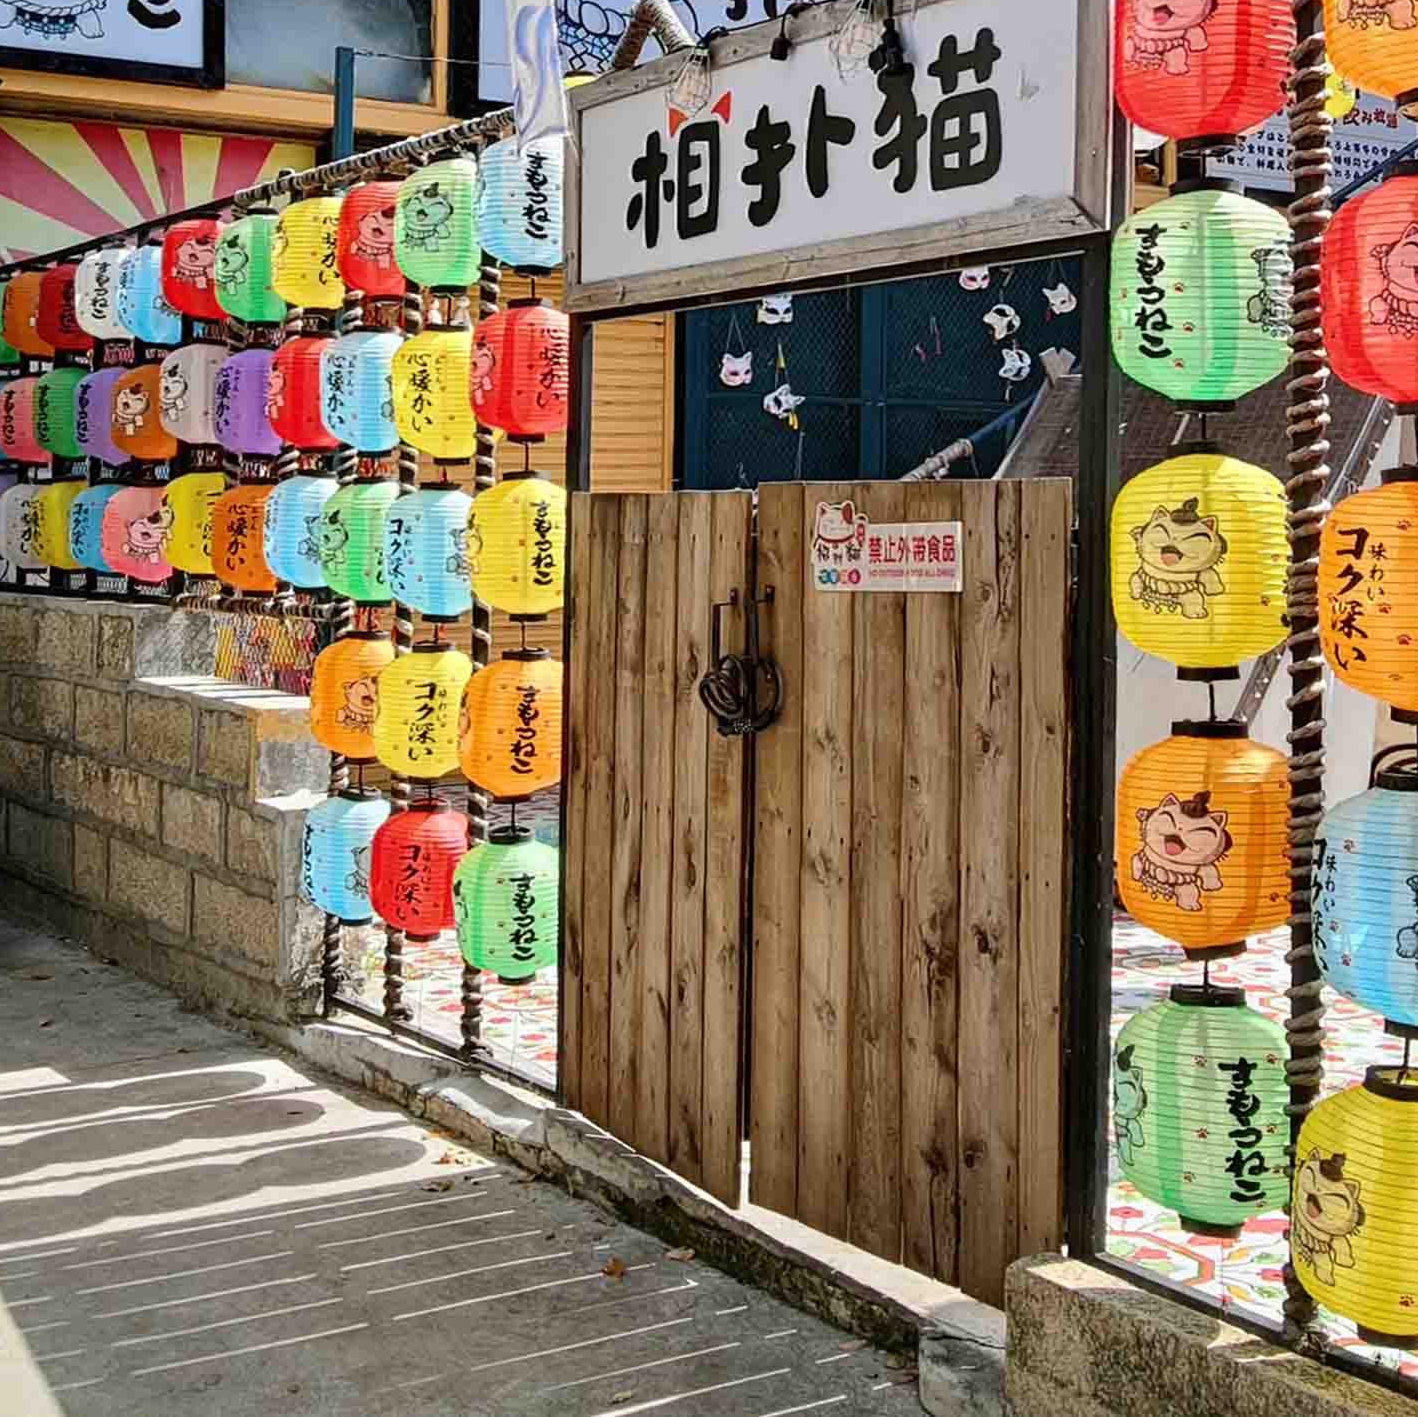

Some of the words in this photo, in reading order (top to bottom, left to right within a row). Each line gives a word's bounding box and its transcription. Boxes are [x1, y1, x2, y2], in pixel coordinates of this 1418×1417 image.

[626, 27, 1002, 249] 相扑猫
[1135, 223, 1173, 358] すもうねこ
[869, 534, 956, 563] 禁止外带食品
[1330, 527, 1369, 671] コク深い
[1367, 541, 1388, 602] 味わい
[408, 682, 437, 762] コク深い
[1217, 1057, 1270, 1202] すもうねこ
